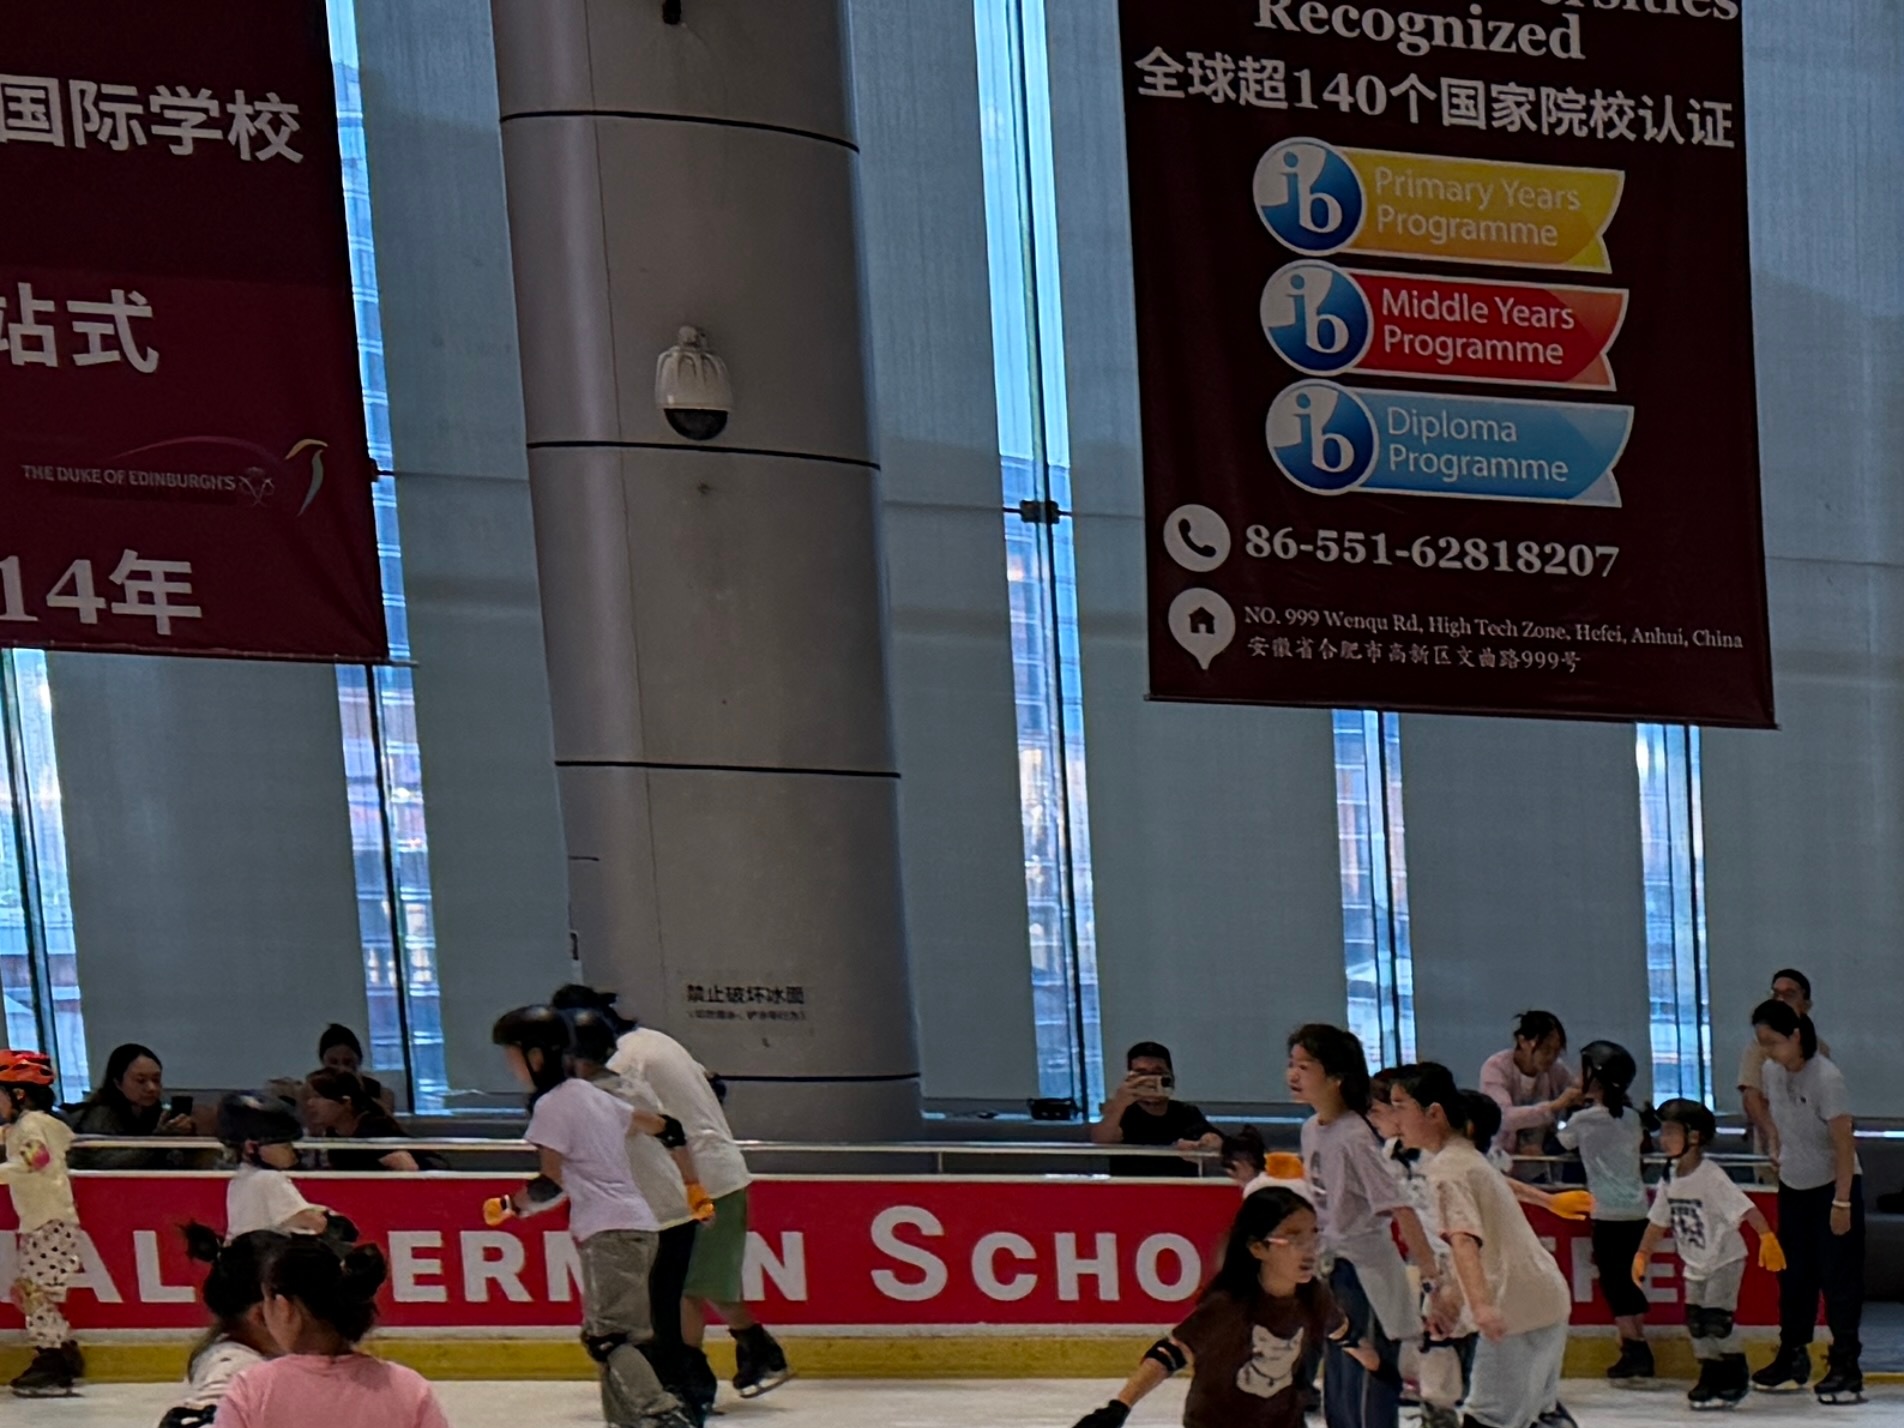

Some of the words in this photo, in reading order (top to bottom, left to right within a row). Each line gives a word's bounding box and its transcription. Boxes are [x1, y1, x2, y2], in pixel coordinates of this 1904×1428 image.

[1253, 0, 1587, 60] Recognized
[0, 73, 304, 163] 国际学校
[1133, 46, 1736, 150] 全球超140个国家院校认证
[1374, 165, 1493, 212] Primary
[1500, 180, 1582, 212] Years
[1376, 204, 1560, 247] Programme
[1381, 287, 1490, 325] Middle
[1494, 296, 1576, 331] Years
[1383, 324, 1565, 367] Programme
[1386, 406, 1518, 444] Diploma
[21, 463, 56, 481] THE
[56, 466, 101, 485] DUKE
[103, 468, 125, 485] OF
[1388, 443, 1570, 484] Programme
[1245, 524, 1621, 578] 86-551-62818207
[1244, 605, 1281, 625] NO.
[1284, 607, 1321, 627] 999
[1323, 609, 1389, 635] Wenqu
[1428, 615, 1472, 638] High
[1474, 618, 1519, 638] Tech
[1692, 629, 1743, 649] China
[870, 1205, 1201, 1303] SCHO
